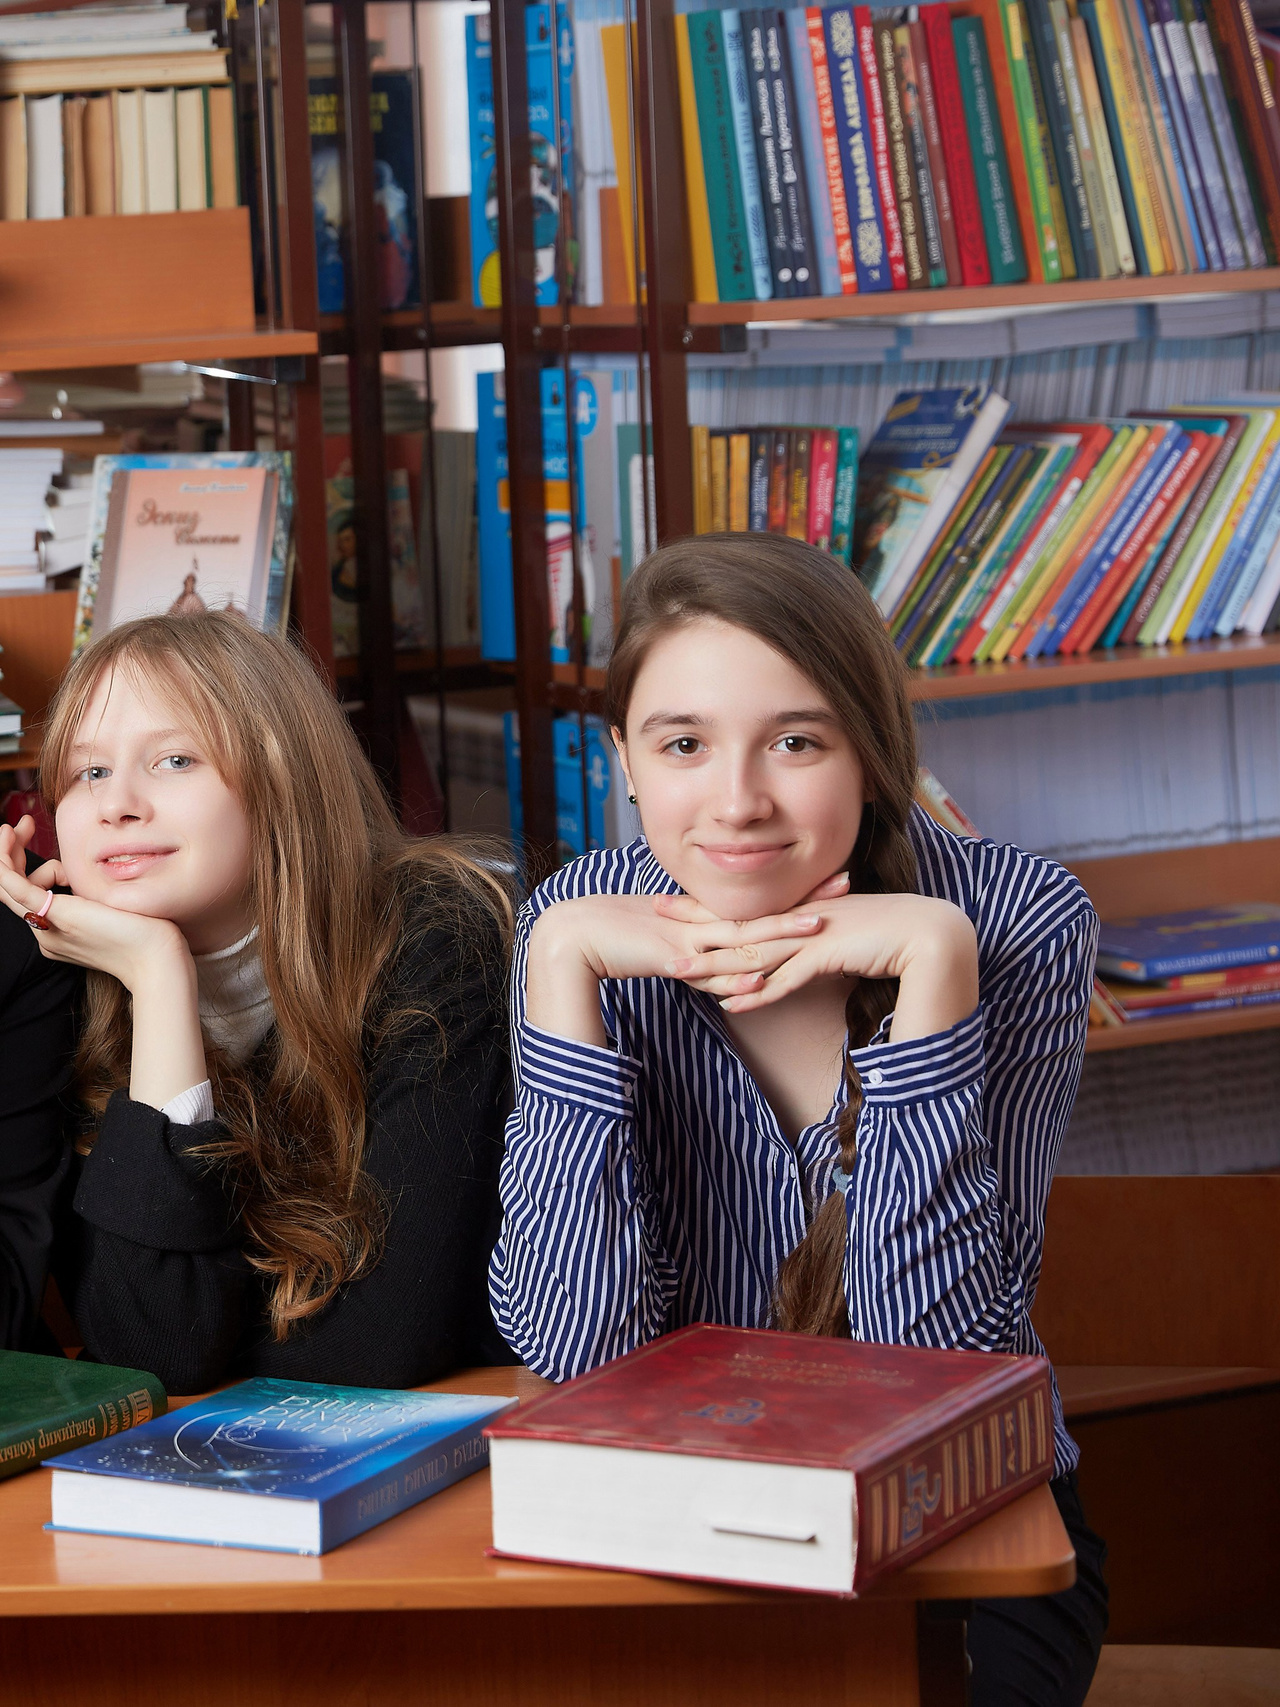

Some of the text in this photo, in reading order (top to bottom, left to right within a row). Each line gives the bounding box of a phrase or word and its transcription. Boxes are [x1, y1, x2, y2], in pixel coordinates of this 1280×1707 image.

[848, 130, 875, 220] КОРОЛЕВА
[1155, 947, 1267, 972] МАЛЕНЬКИЙ ПРИНЦ
[38, 1416, 96, 1451] Владимир
